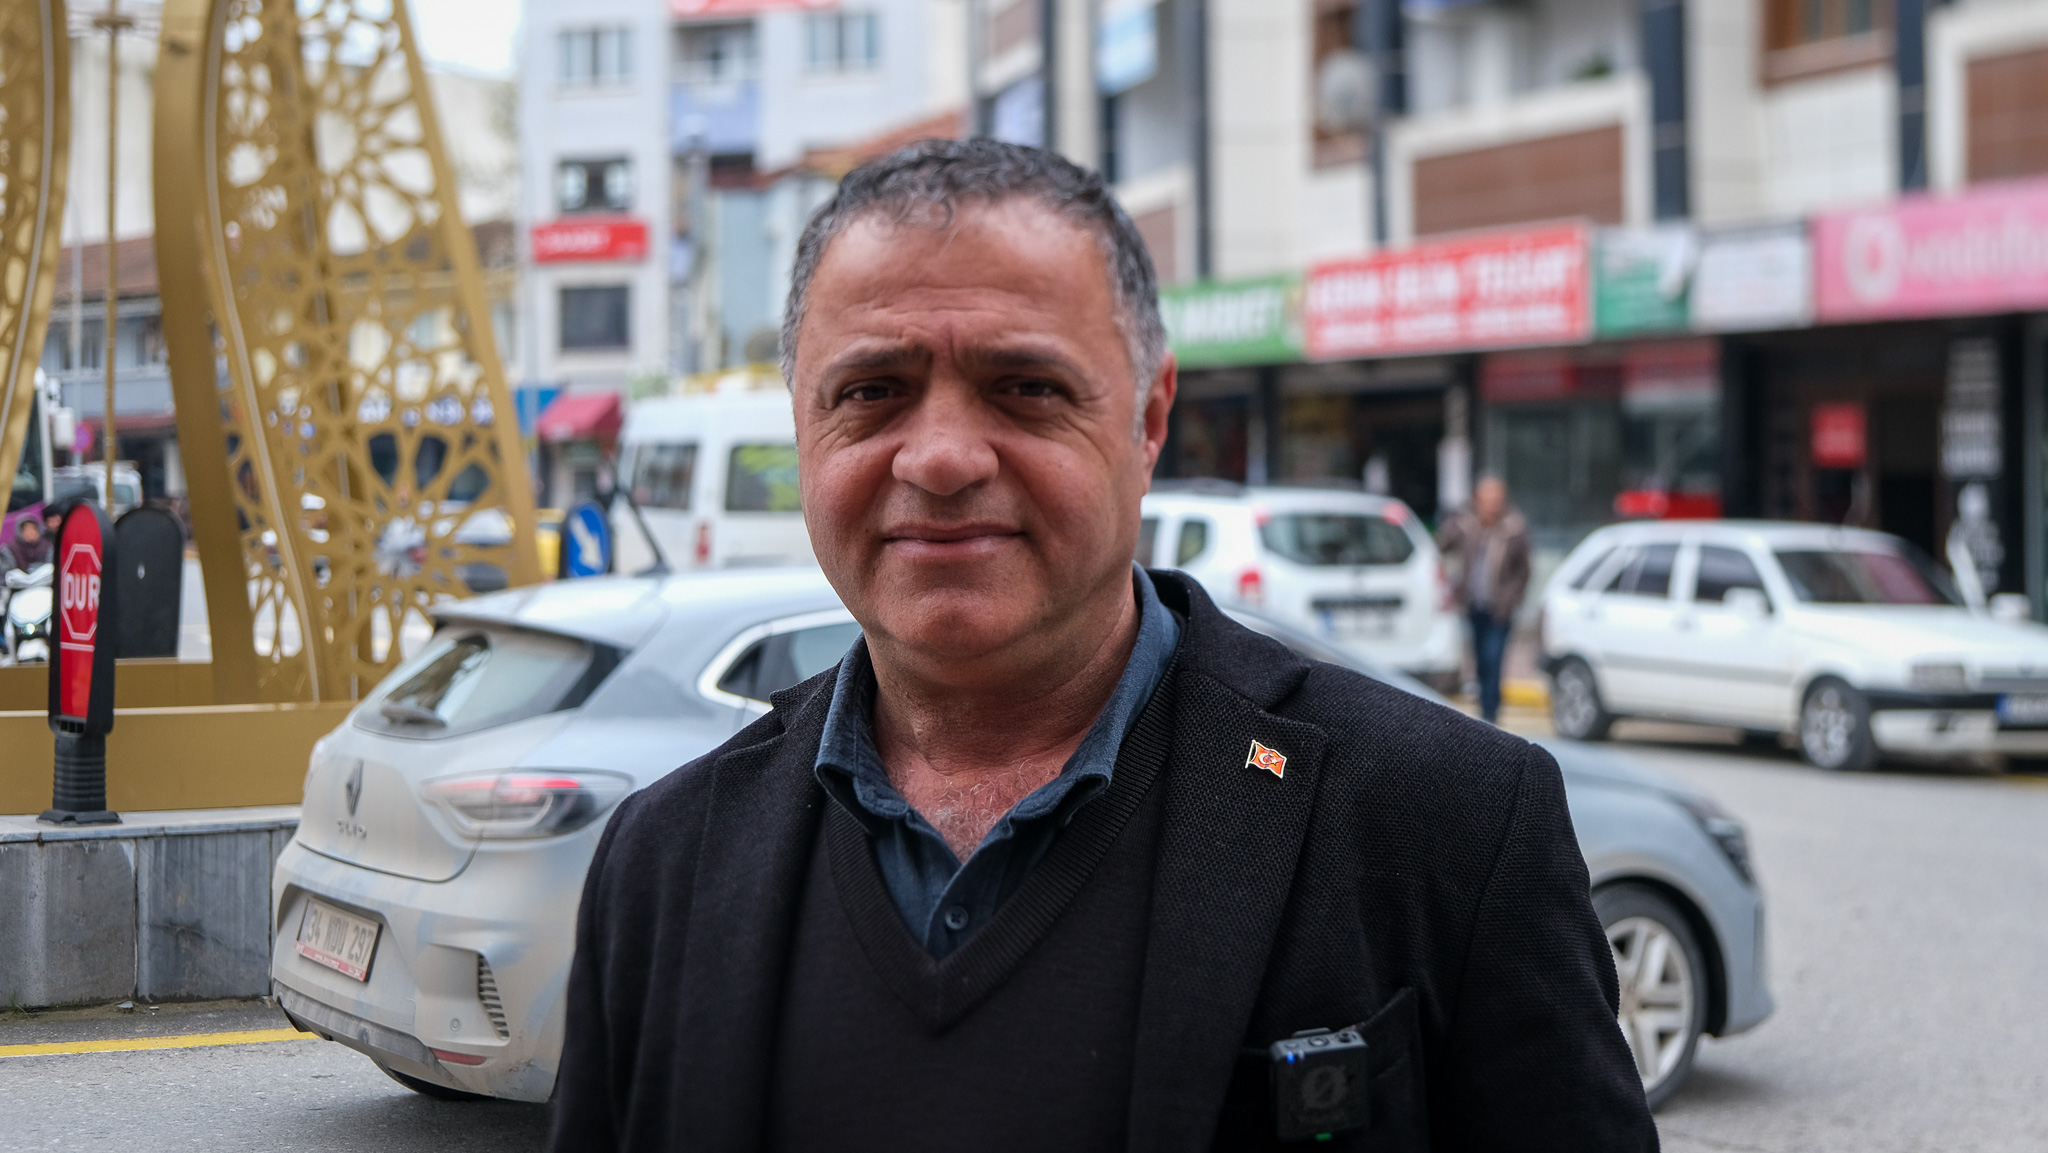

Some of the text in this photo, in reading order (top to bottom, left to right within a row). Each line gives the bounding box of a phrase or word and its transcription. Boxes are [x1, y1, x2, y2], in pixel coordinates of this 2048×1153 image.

[63, 573, 100, 611] DUR
[307, 910, 322, 946] 34
[348, 925, 375, 964] 297
